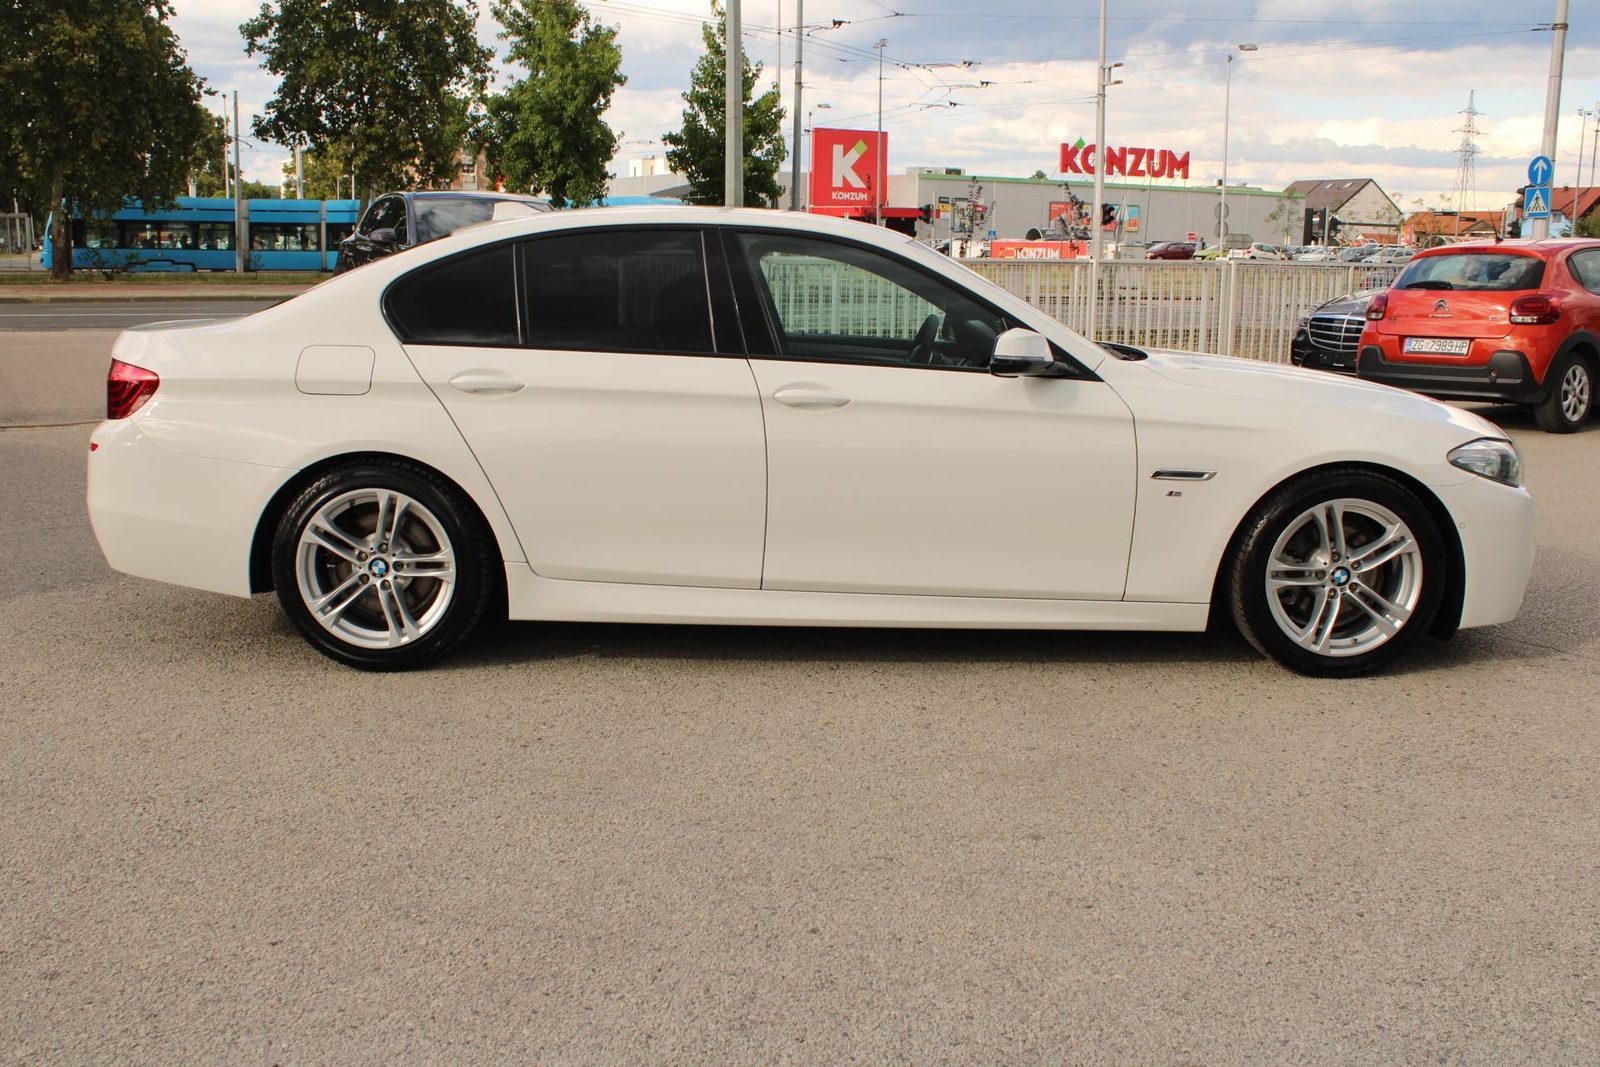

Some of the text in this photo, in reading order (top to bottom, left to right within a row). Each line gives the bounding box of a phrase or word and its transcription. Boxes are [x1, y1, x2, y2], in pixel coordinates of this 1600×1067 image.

[832, 139, 868, 188] K
[1060, 137, 1190, 179] KONZUM
[832, 191, 868, 201] KONZUM
[1411, 339, 1425, 351] ZG
